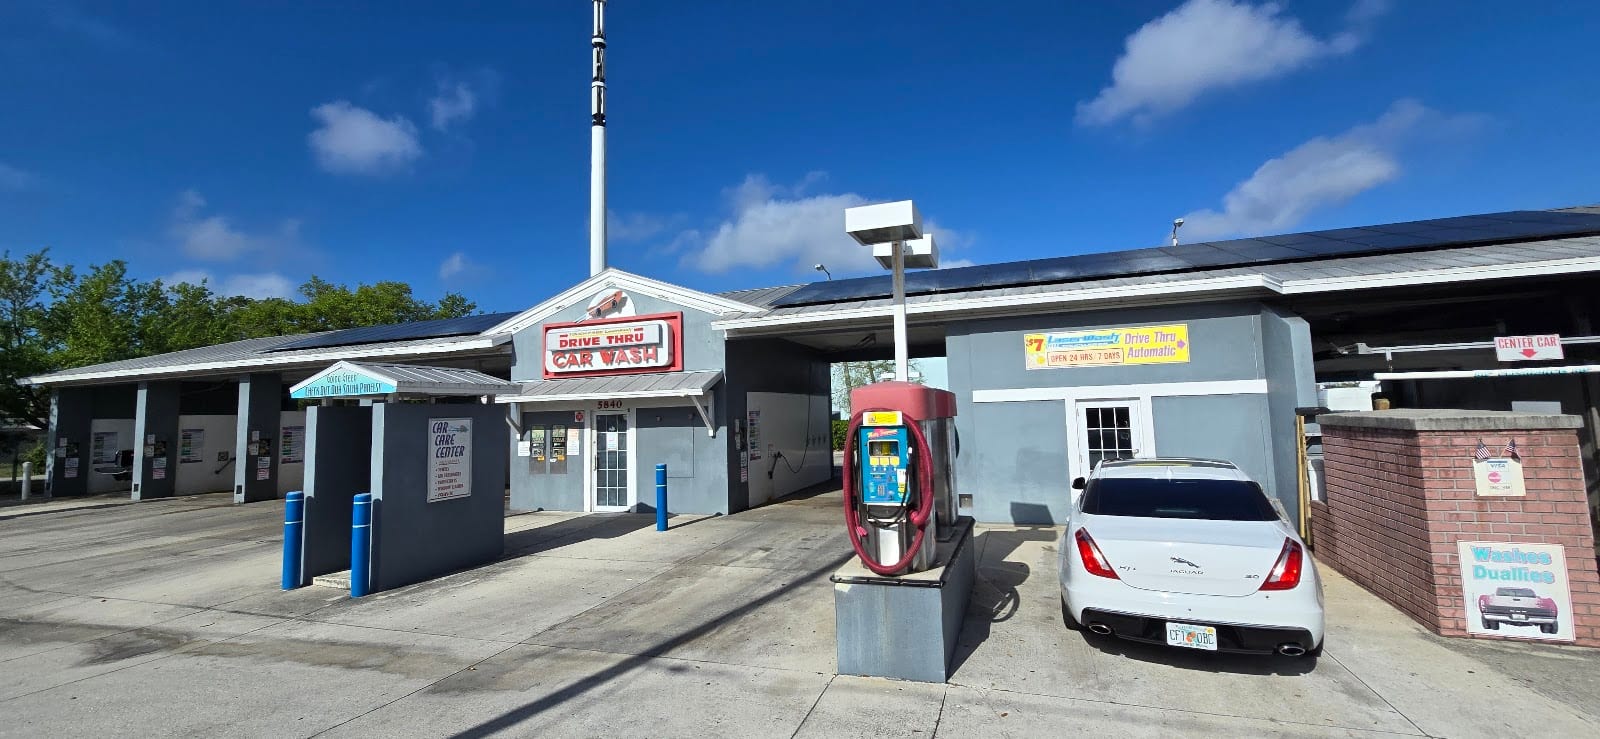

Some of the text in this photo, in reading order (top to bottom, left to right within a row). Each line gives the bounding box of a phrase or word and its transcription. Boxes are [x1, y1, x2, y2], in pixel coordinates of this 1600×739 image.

[559, 332, 644, 348] DRIVE THRU
[1125, 331, 1176, 344] Drive Thru
[1498, 336, 1557, 350] CENTER CAR
[552, 346, 658, 369] CAR WASH
[1051, 354, 1068, 363] OPEN
[1069, 354, 1078, 362] 24
[1080, 353, 1093, 361] HRS
[1104, 351, 1121, 360] DAYS
[1127, 346, 1176, 358] Automatic
[597, 400, 622, 409] 5840
[432, 421, 449, 434] CAR
[434, 433, 456, 446] CARE
[436, 445, 465, 458] CENTER
[1471, 546, 1553, 565] Washes
[1472, 564, 1556, 584] Duallies
